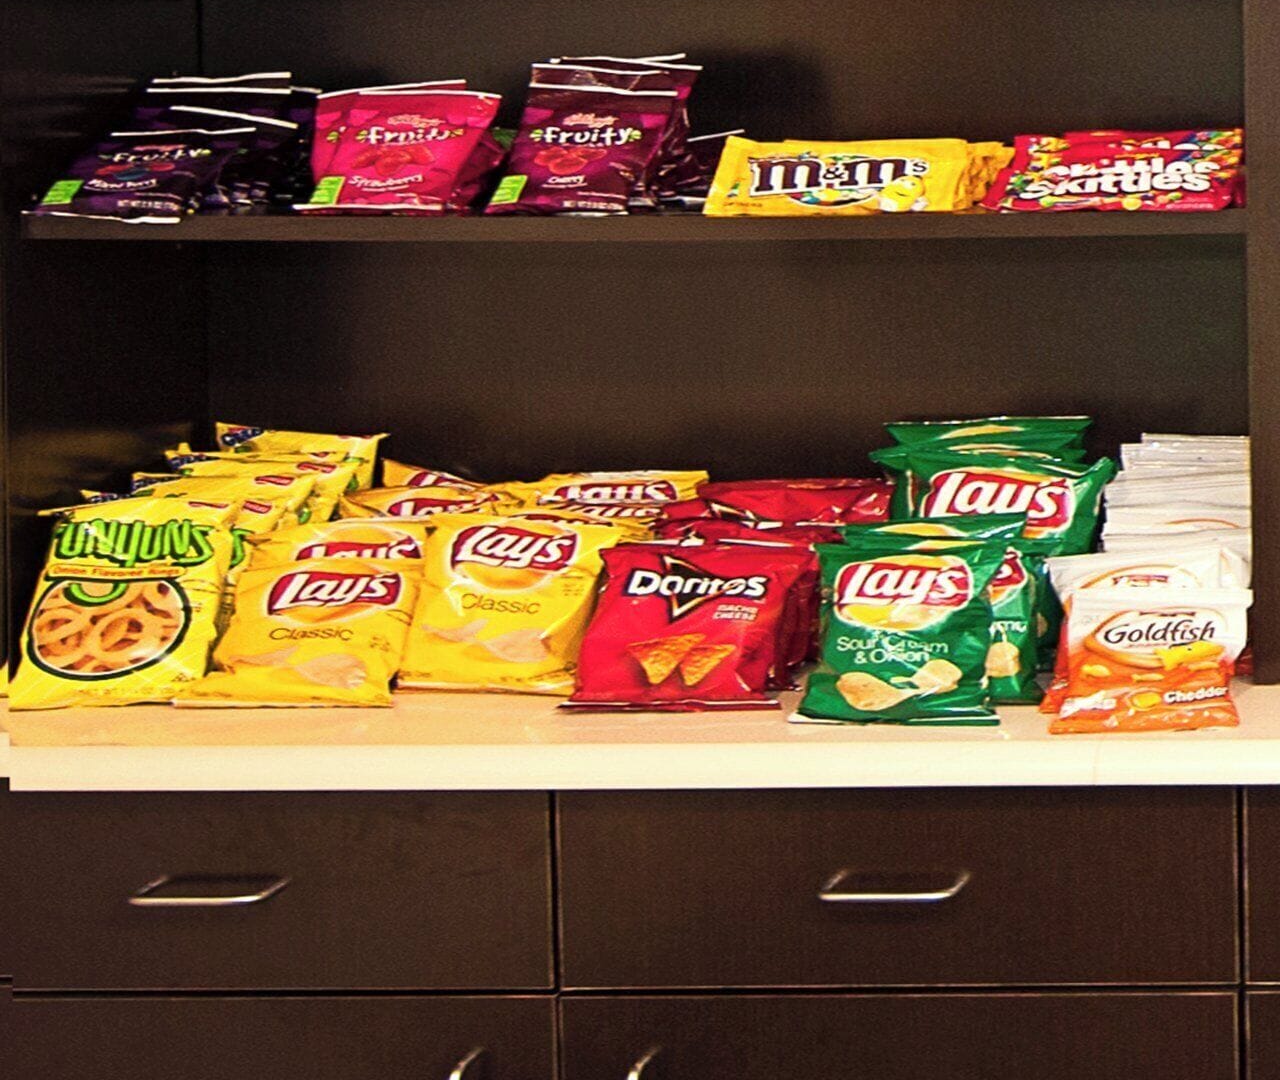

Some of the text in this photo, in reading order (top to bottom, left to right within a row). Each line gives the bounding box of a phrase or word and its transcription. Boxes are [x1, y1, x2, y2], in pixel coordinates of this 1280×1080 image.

[932, 471, 1069, 520] Lay's
[456, 526, 575, 568] Lay's
[272, 572, 401, 612] Lay's
[837, 561, 971, 606] Lay's
[461, 592, 541, 616] Classic
[269, 627, 354, 642] Classic
[838, 636, 949, 653] Sour Cream
[1103, 619, 1217, 645] Goldfish
[854, 648, 930, 664] & Onion
[1163, 686, 1229, 705] Cheddar
